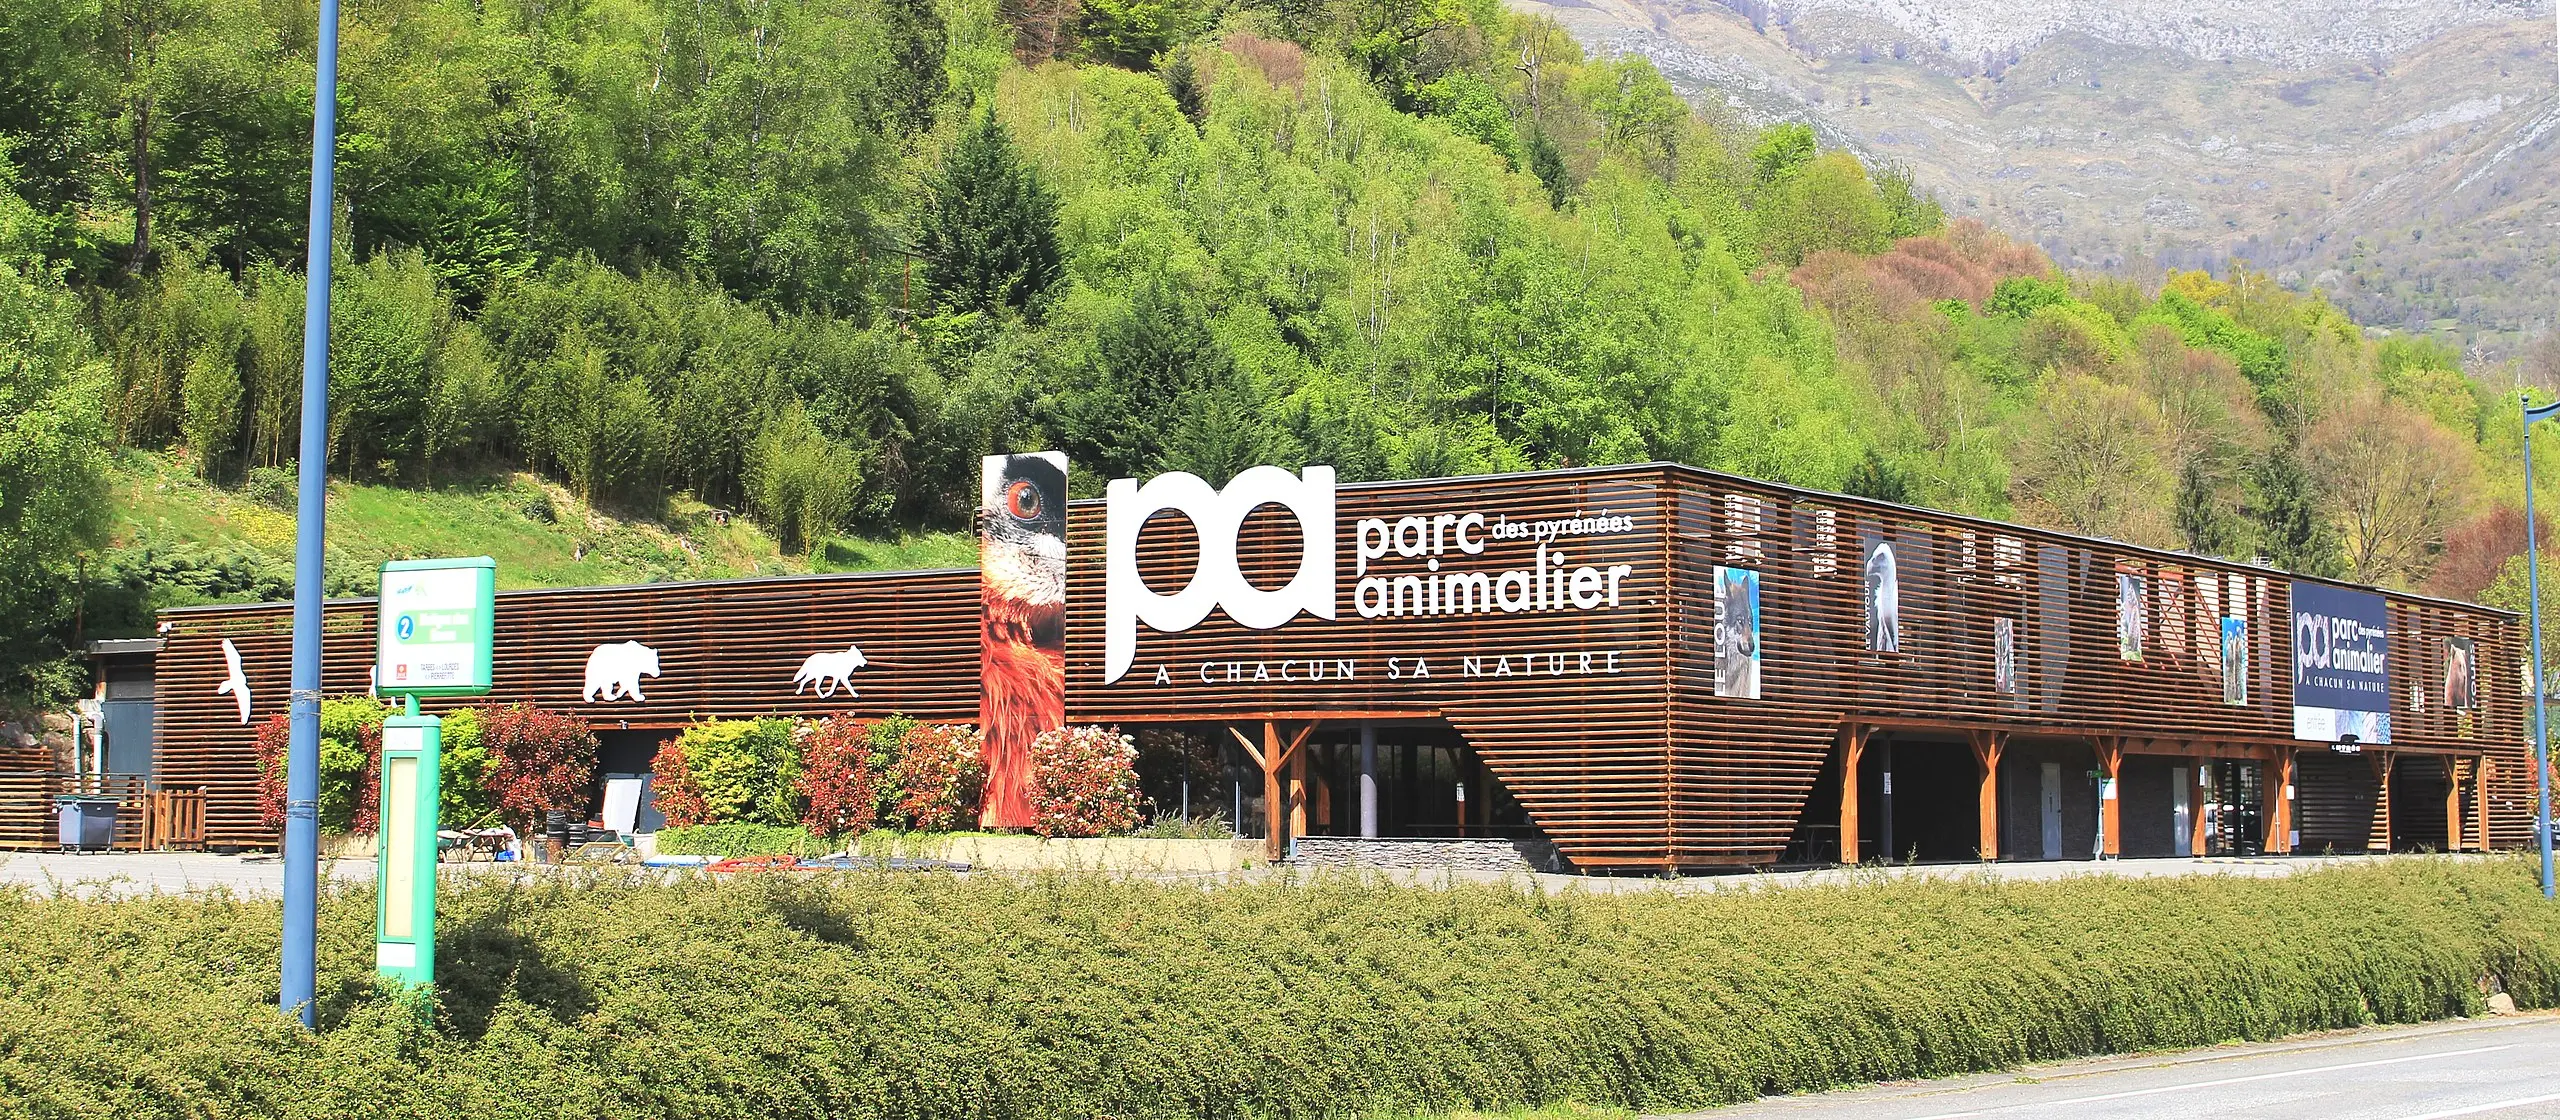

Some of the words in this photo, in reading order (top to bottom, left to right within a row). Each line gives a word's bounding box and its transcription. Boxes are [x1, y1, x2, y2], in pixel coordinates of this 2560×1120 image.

[1356, 512, 1486, 578] parc
[1491, 513, 1529, 540] des
[1534, 507, 1634, 543] pyrénées
[1104, 464, 1337, 686] pa
[1354, 542, 1633, 619] animalier
[399, 616, 411, 638] 2
[2331, 616, 2358, 648] parc
[2296, 611, 2331, 685] pa
[2332, 639, 2386, 675] animalier
[1154, 663, 1172, 686] A
[1200, 658, 1355, 684] CHACUN
[1387, 656, 1431, 680] SA
[1463, 651, 1623, 678] NATURE
[2305, 675, 2310, 686] A
[2314, 676, 2343, 689] CHACUN
[2346, 679, 2356, 690] SA
[2358, 681, 2385, 693] NATURE
